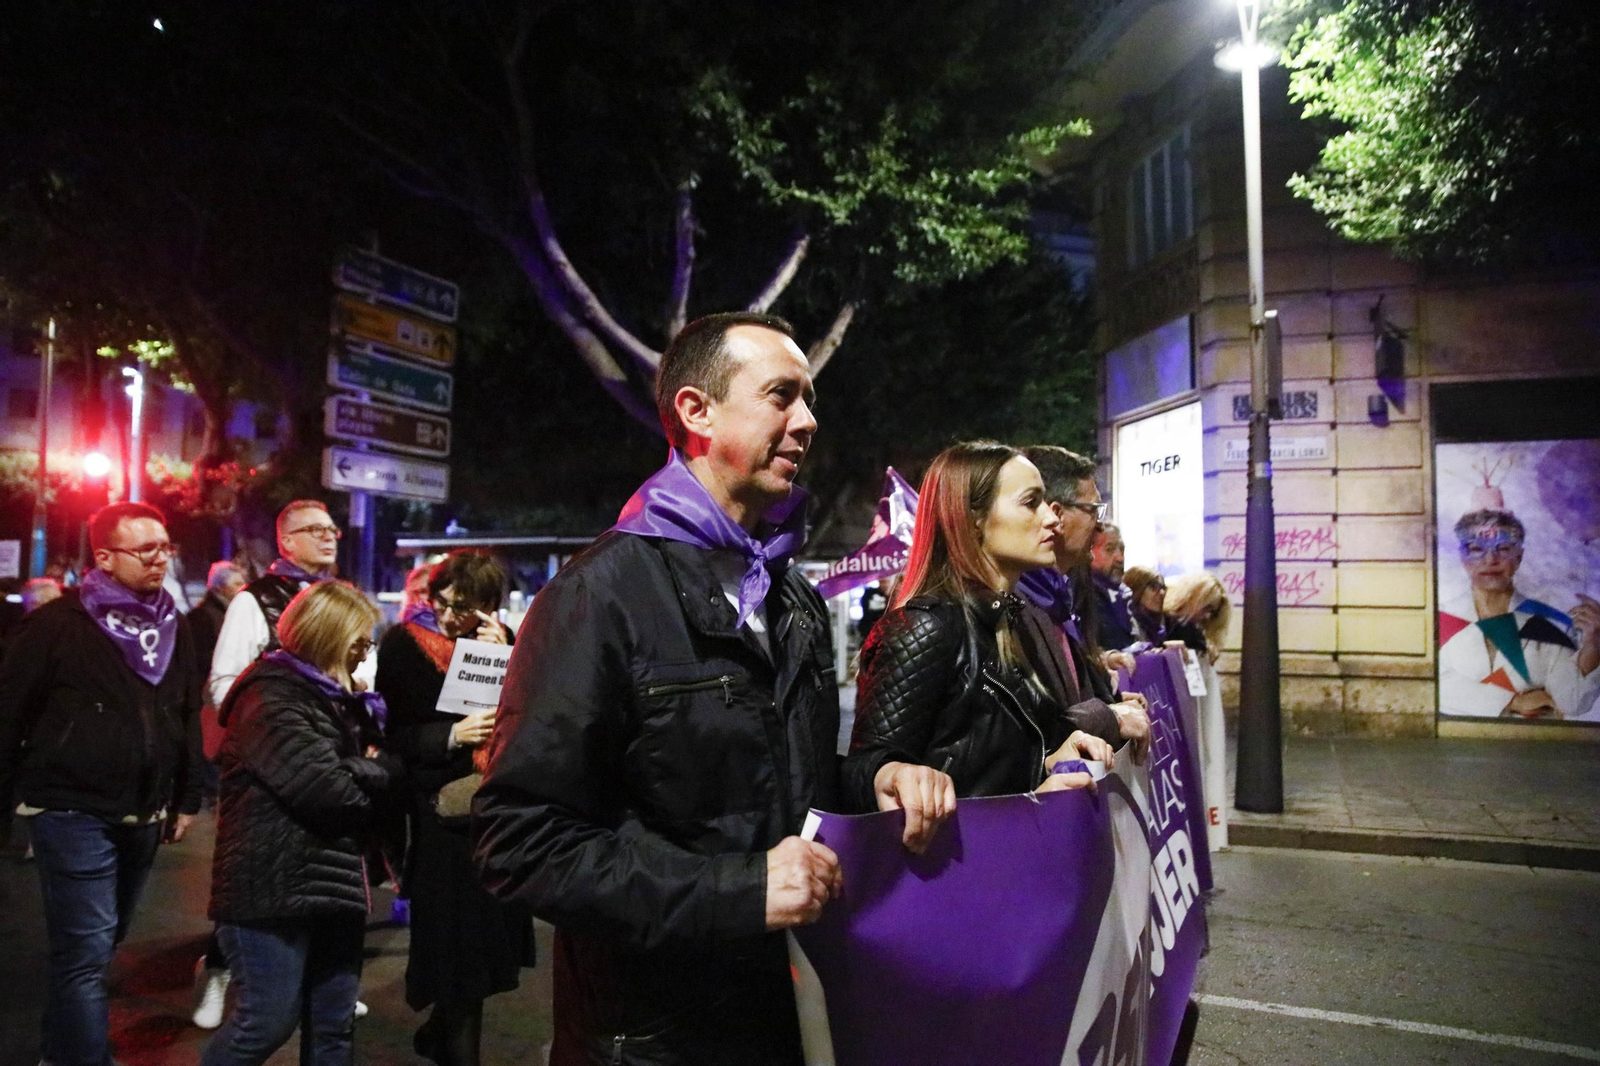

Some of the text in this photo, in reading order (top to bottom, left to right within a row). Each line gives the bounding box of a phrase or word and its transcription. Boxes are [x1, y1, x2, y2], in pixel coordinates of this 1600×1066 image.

[1140, 454, 1181, 477] TIGER
[463, 653, 491, 666] María
[458, 670, 497, 685] Carmen
